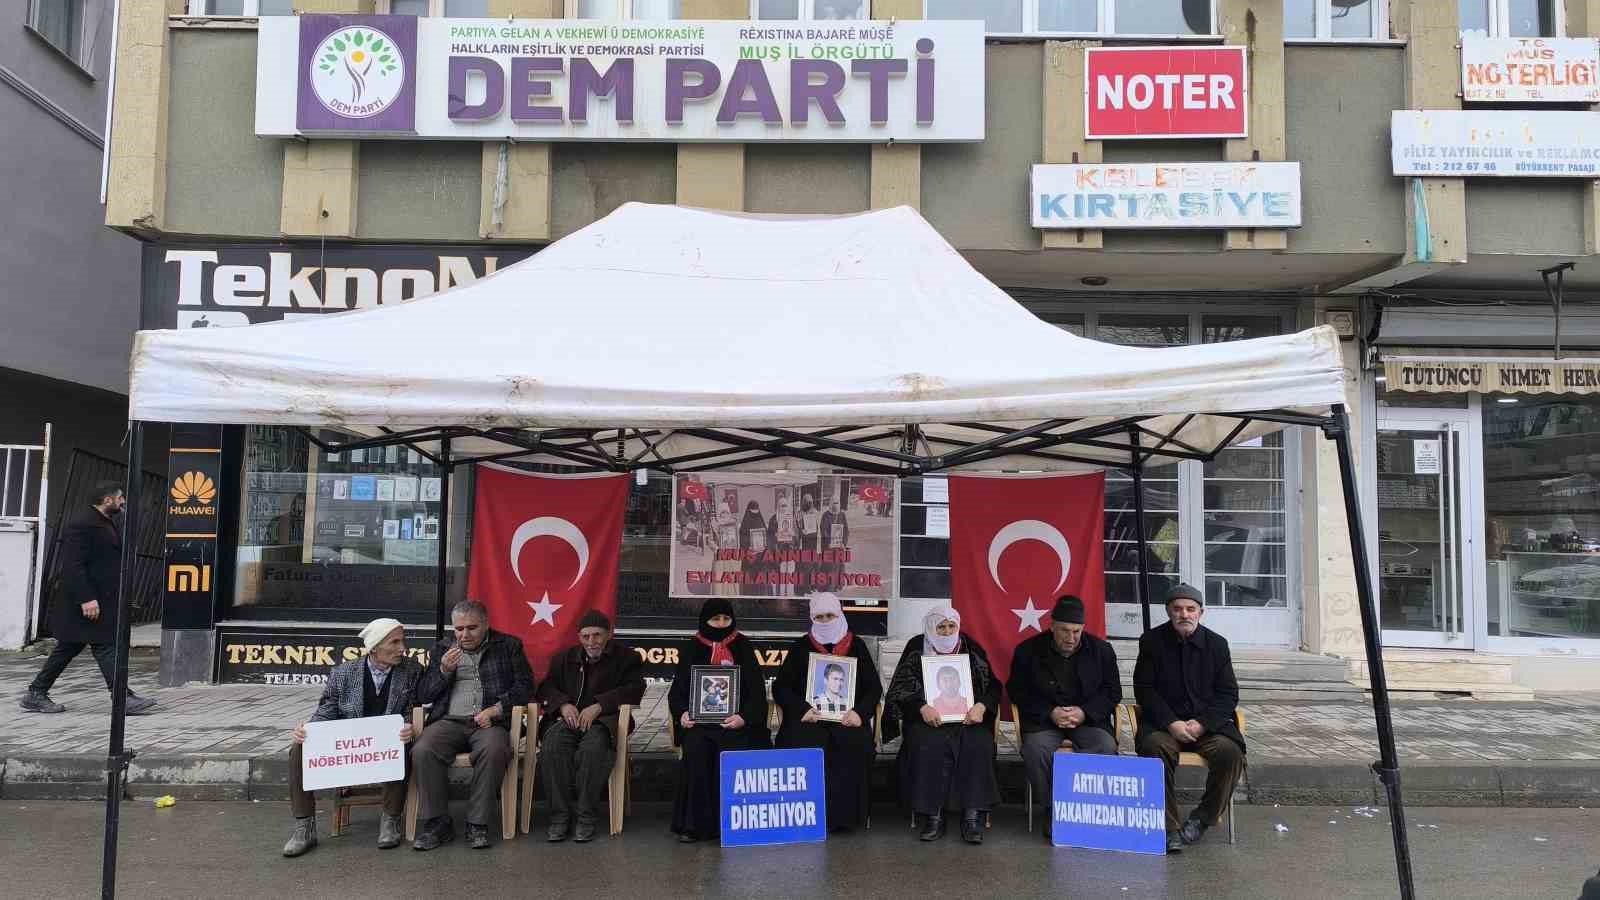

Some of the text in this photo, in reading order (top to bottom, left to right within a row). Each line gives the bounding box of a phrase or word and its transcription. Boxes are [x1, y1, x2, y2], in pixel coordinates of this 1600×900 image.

[450, 27, 497, 38] PARTIYA
[500, 28, 540, 39] GELAN
[543, 28, 553, 38] A
[739, 27, 803, 40] RÊXISTINA
[806, 28, 857, 40] BAJARÊ
[451, 43, 705, 56] HALKLARIN EŞİTLİK VE DEMOKRASİ PARTİSİ
[739, 43, 894, 61] MUŞ İL ÖRGÜTÜ
[448, 38, 935, 127] DEM PARTİ
[1097, 74, 1236, 110] NOTER
[330, 96, 385, 114] DEM PARTİ
[1412, 162, 1431, 171] Tel
[1443, 162, 1463, 171] 212
[1402, 363, 1482, 386] TÜTÜNCÜ
[1499, 364, 1551, 386] NİMET
[169, 506, 216, 515] HUAWEI
[335, 737, 374, 750] EVLAT
[308, 749, 399, 769] NÖBETİNDEYİZ
[733, 766, 807, 794] ANNELER
[1073, 773, 1104, 794] ARTIK
[1106, 775, 1139, 797] YETER
[730, 795, 817, 831] DİRENİYOR
[1054, 800, 1166, 836] YAKAMIZDAN DÜŞÜN
